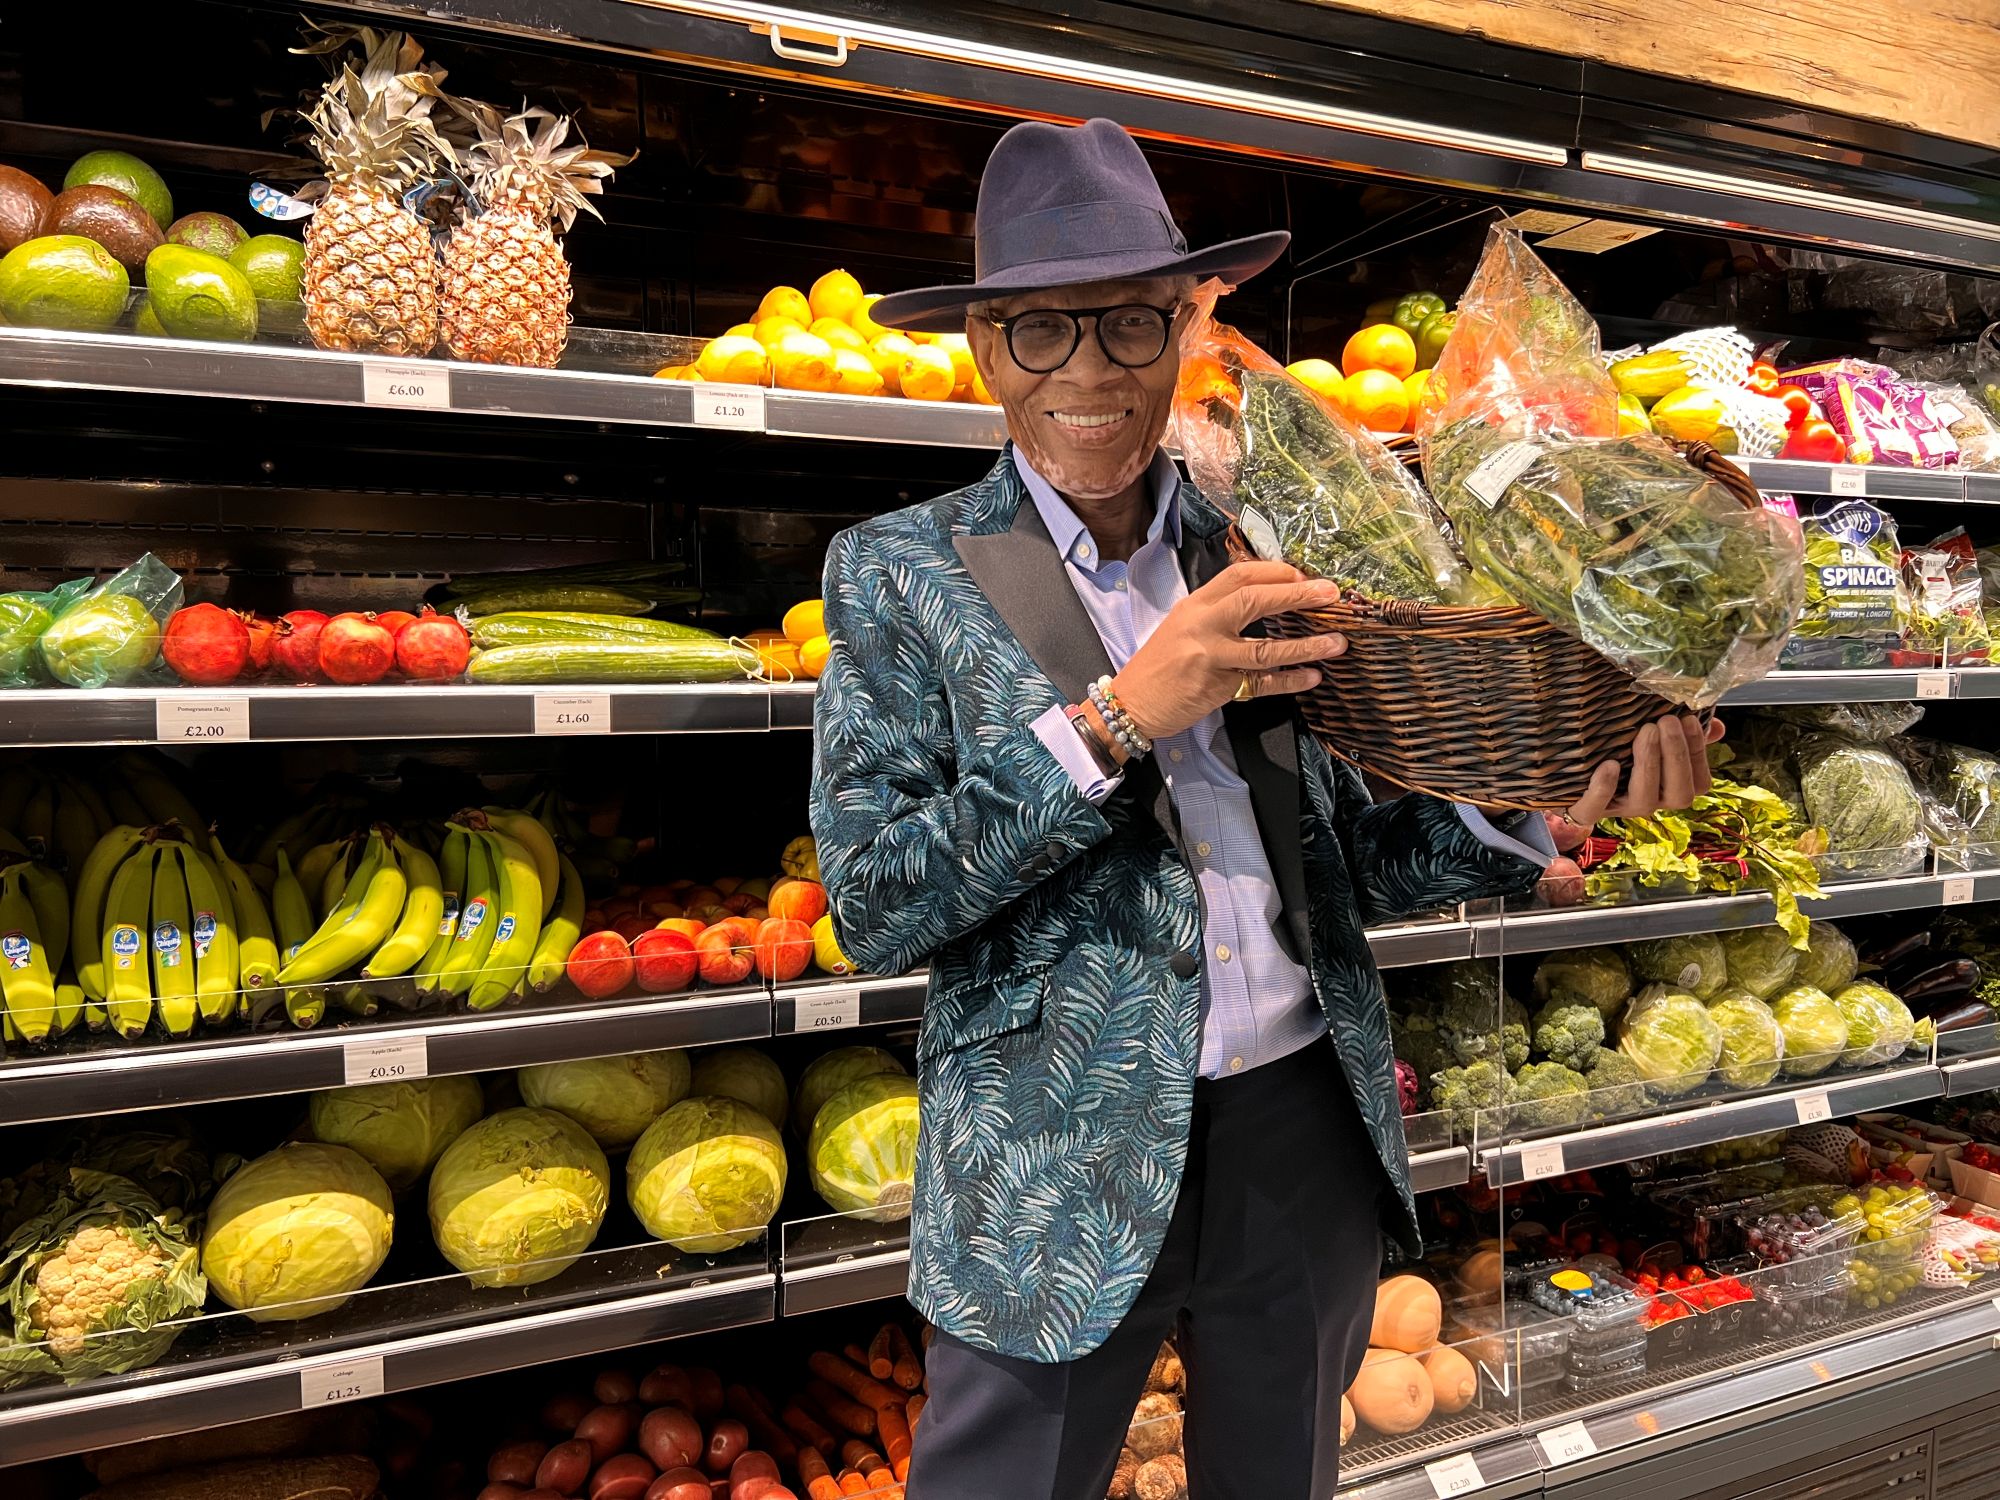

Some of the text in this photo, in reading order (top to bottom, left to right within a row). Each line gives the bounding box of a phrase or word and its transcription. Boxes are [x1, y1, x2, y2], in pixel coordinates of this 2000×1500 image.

[388, 384, 424, 396] £6.00
[714, 405, 745, 417] £1.20
[1827, 510, 1872, 534] LEAVES
[1822, 567, 1896, 586] SPINACH
[556, 713, 590, 724] £1.60
[184, 726, 224, 737] £2.00
[814, 1015, 842, 1027] £0.50
[386, 1046, 403, 1054] (Each)
[369, 1065, 405, 1078] £0.50
[332, 1370, 354, 1378] Cabbage
[325, 1385, 361, 1401] £1.25
